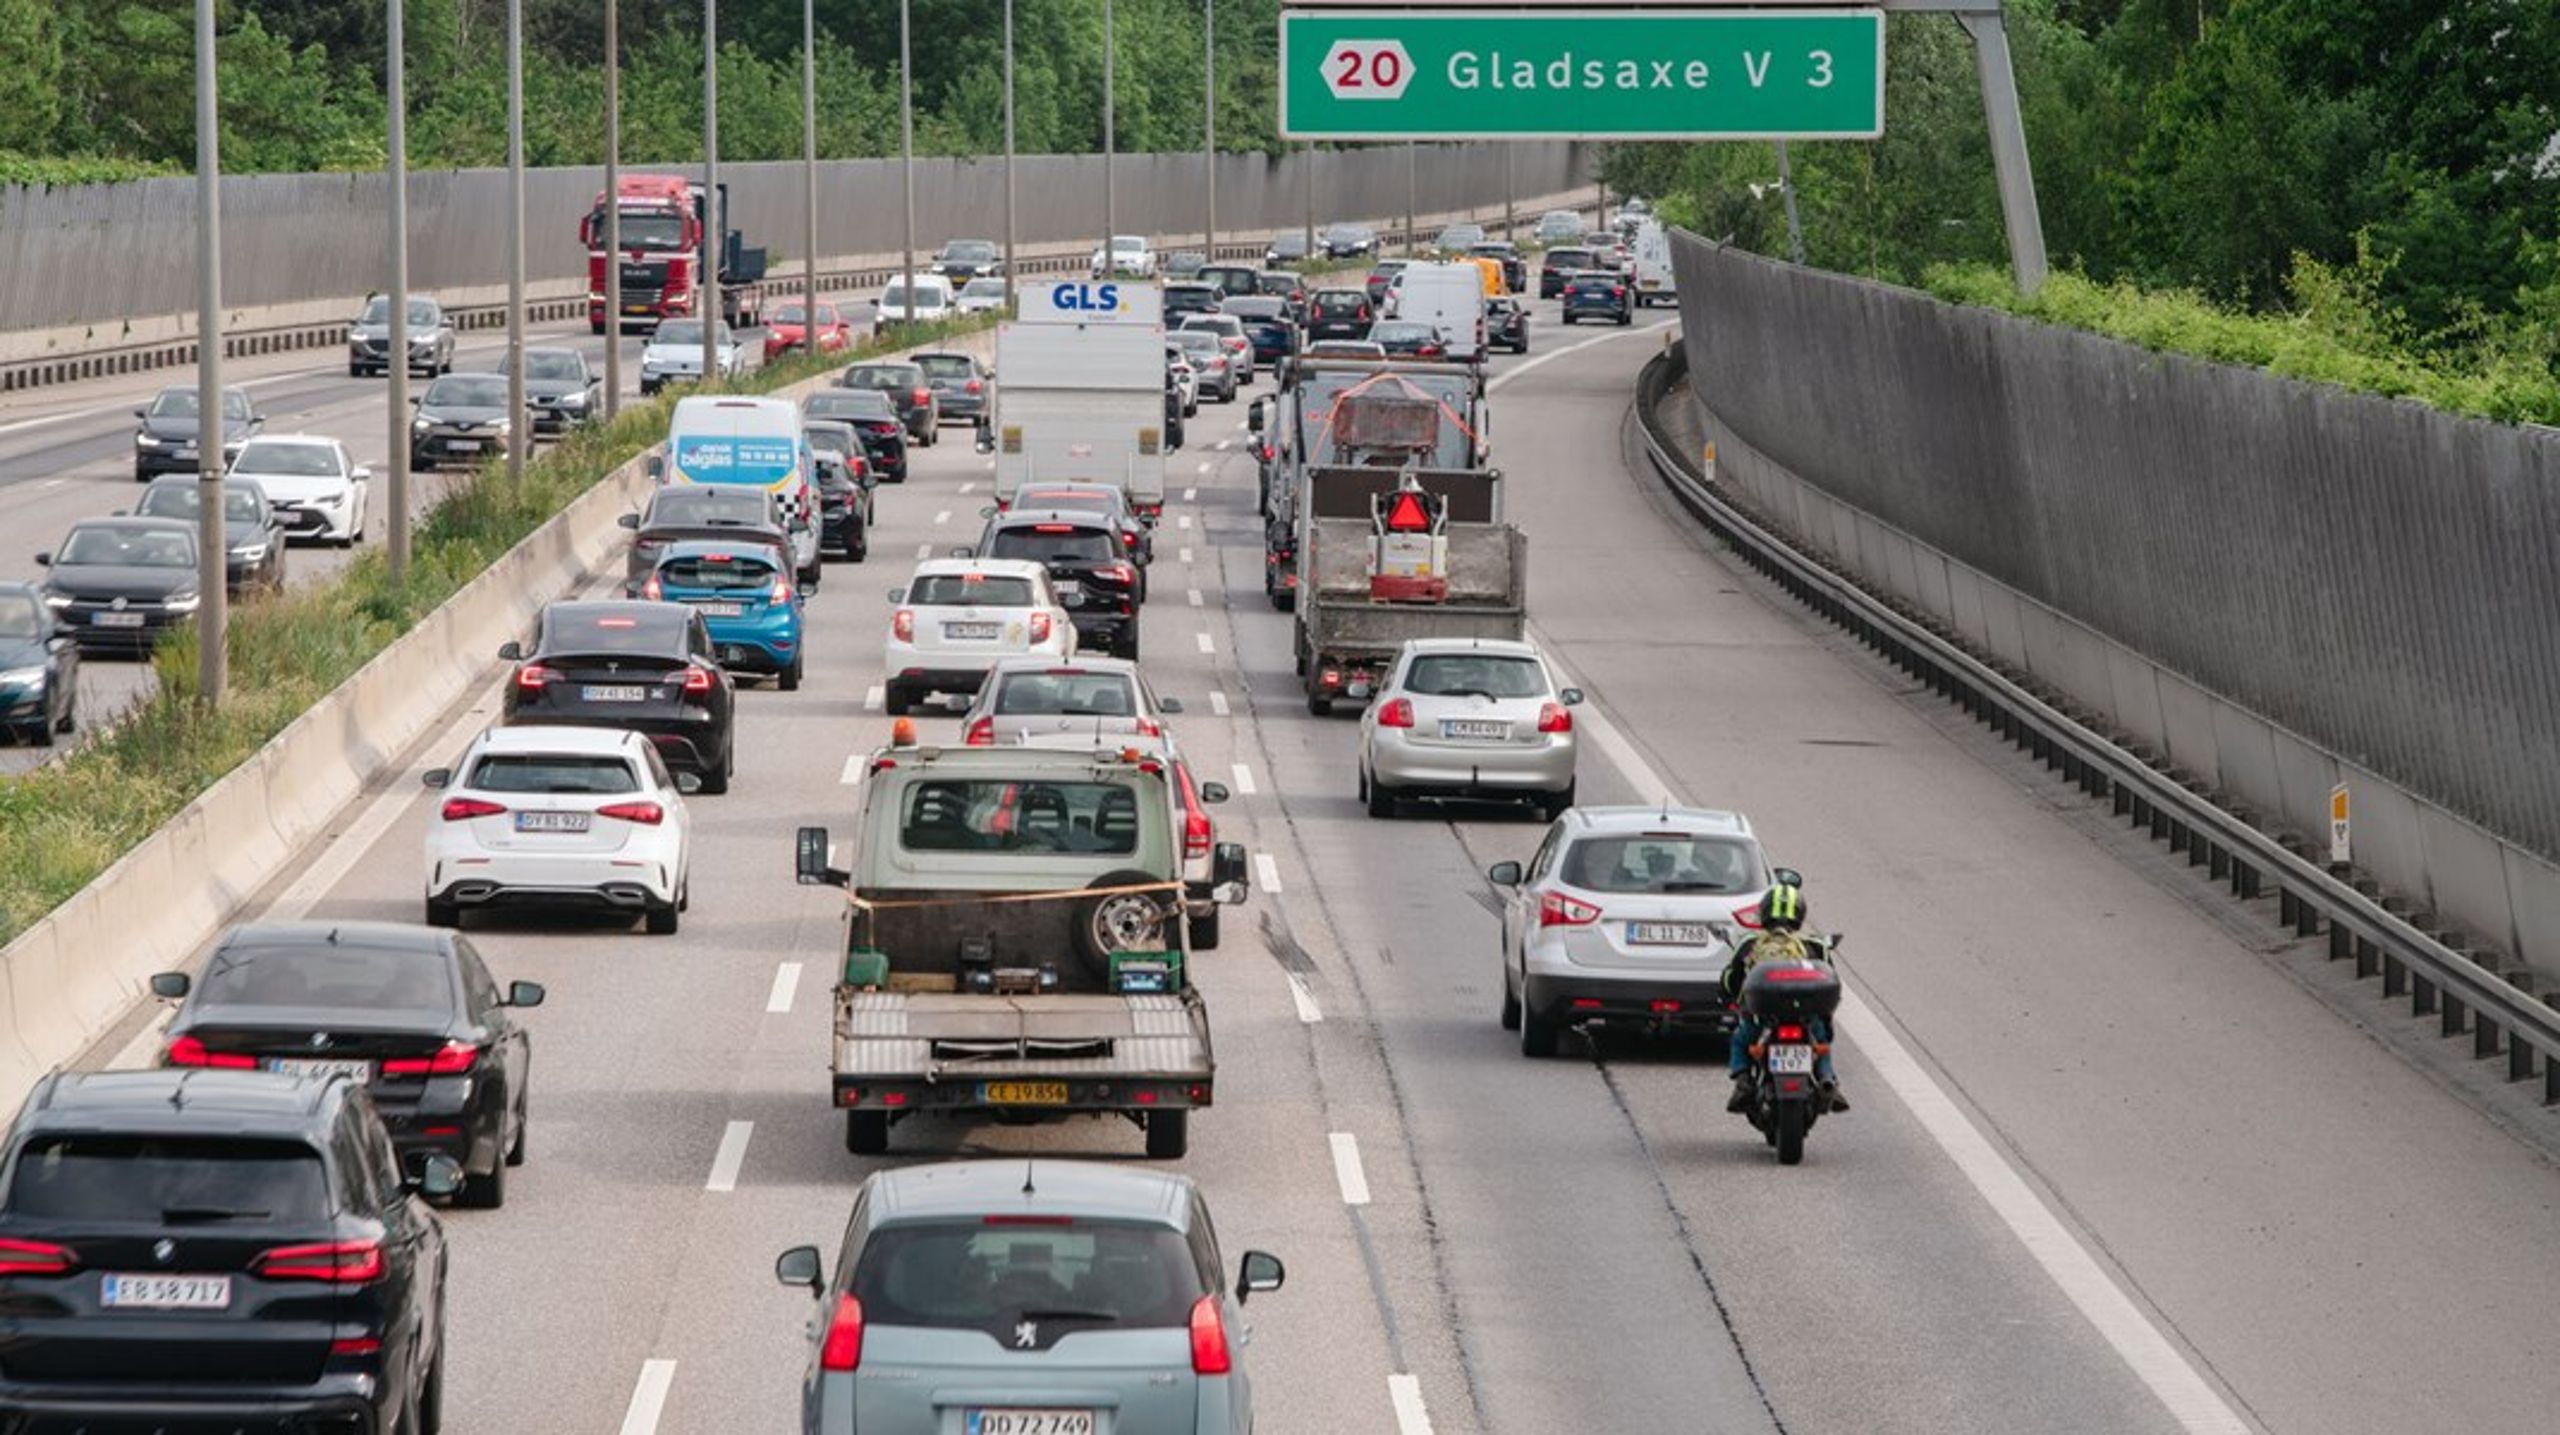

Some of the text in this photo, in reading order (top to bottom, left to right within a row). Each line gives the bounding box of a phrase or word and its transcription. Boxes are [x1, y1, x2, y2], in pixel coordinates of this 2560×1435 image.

[1336, 50, 1834, 89] 20 Gladsaxe V 3
[1052, 283, 1119, 311] GLS
[987, 1083, 1007, 1100] CE
[184, 1282, 225, 1301] 717
[982, 1415, 1089, 1434] DD 72 749
